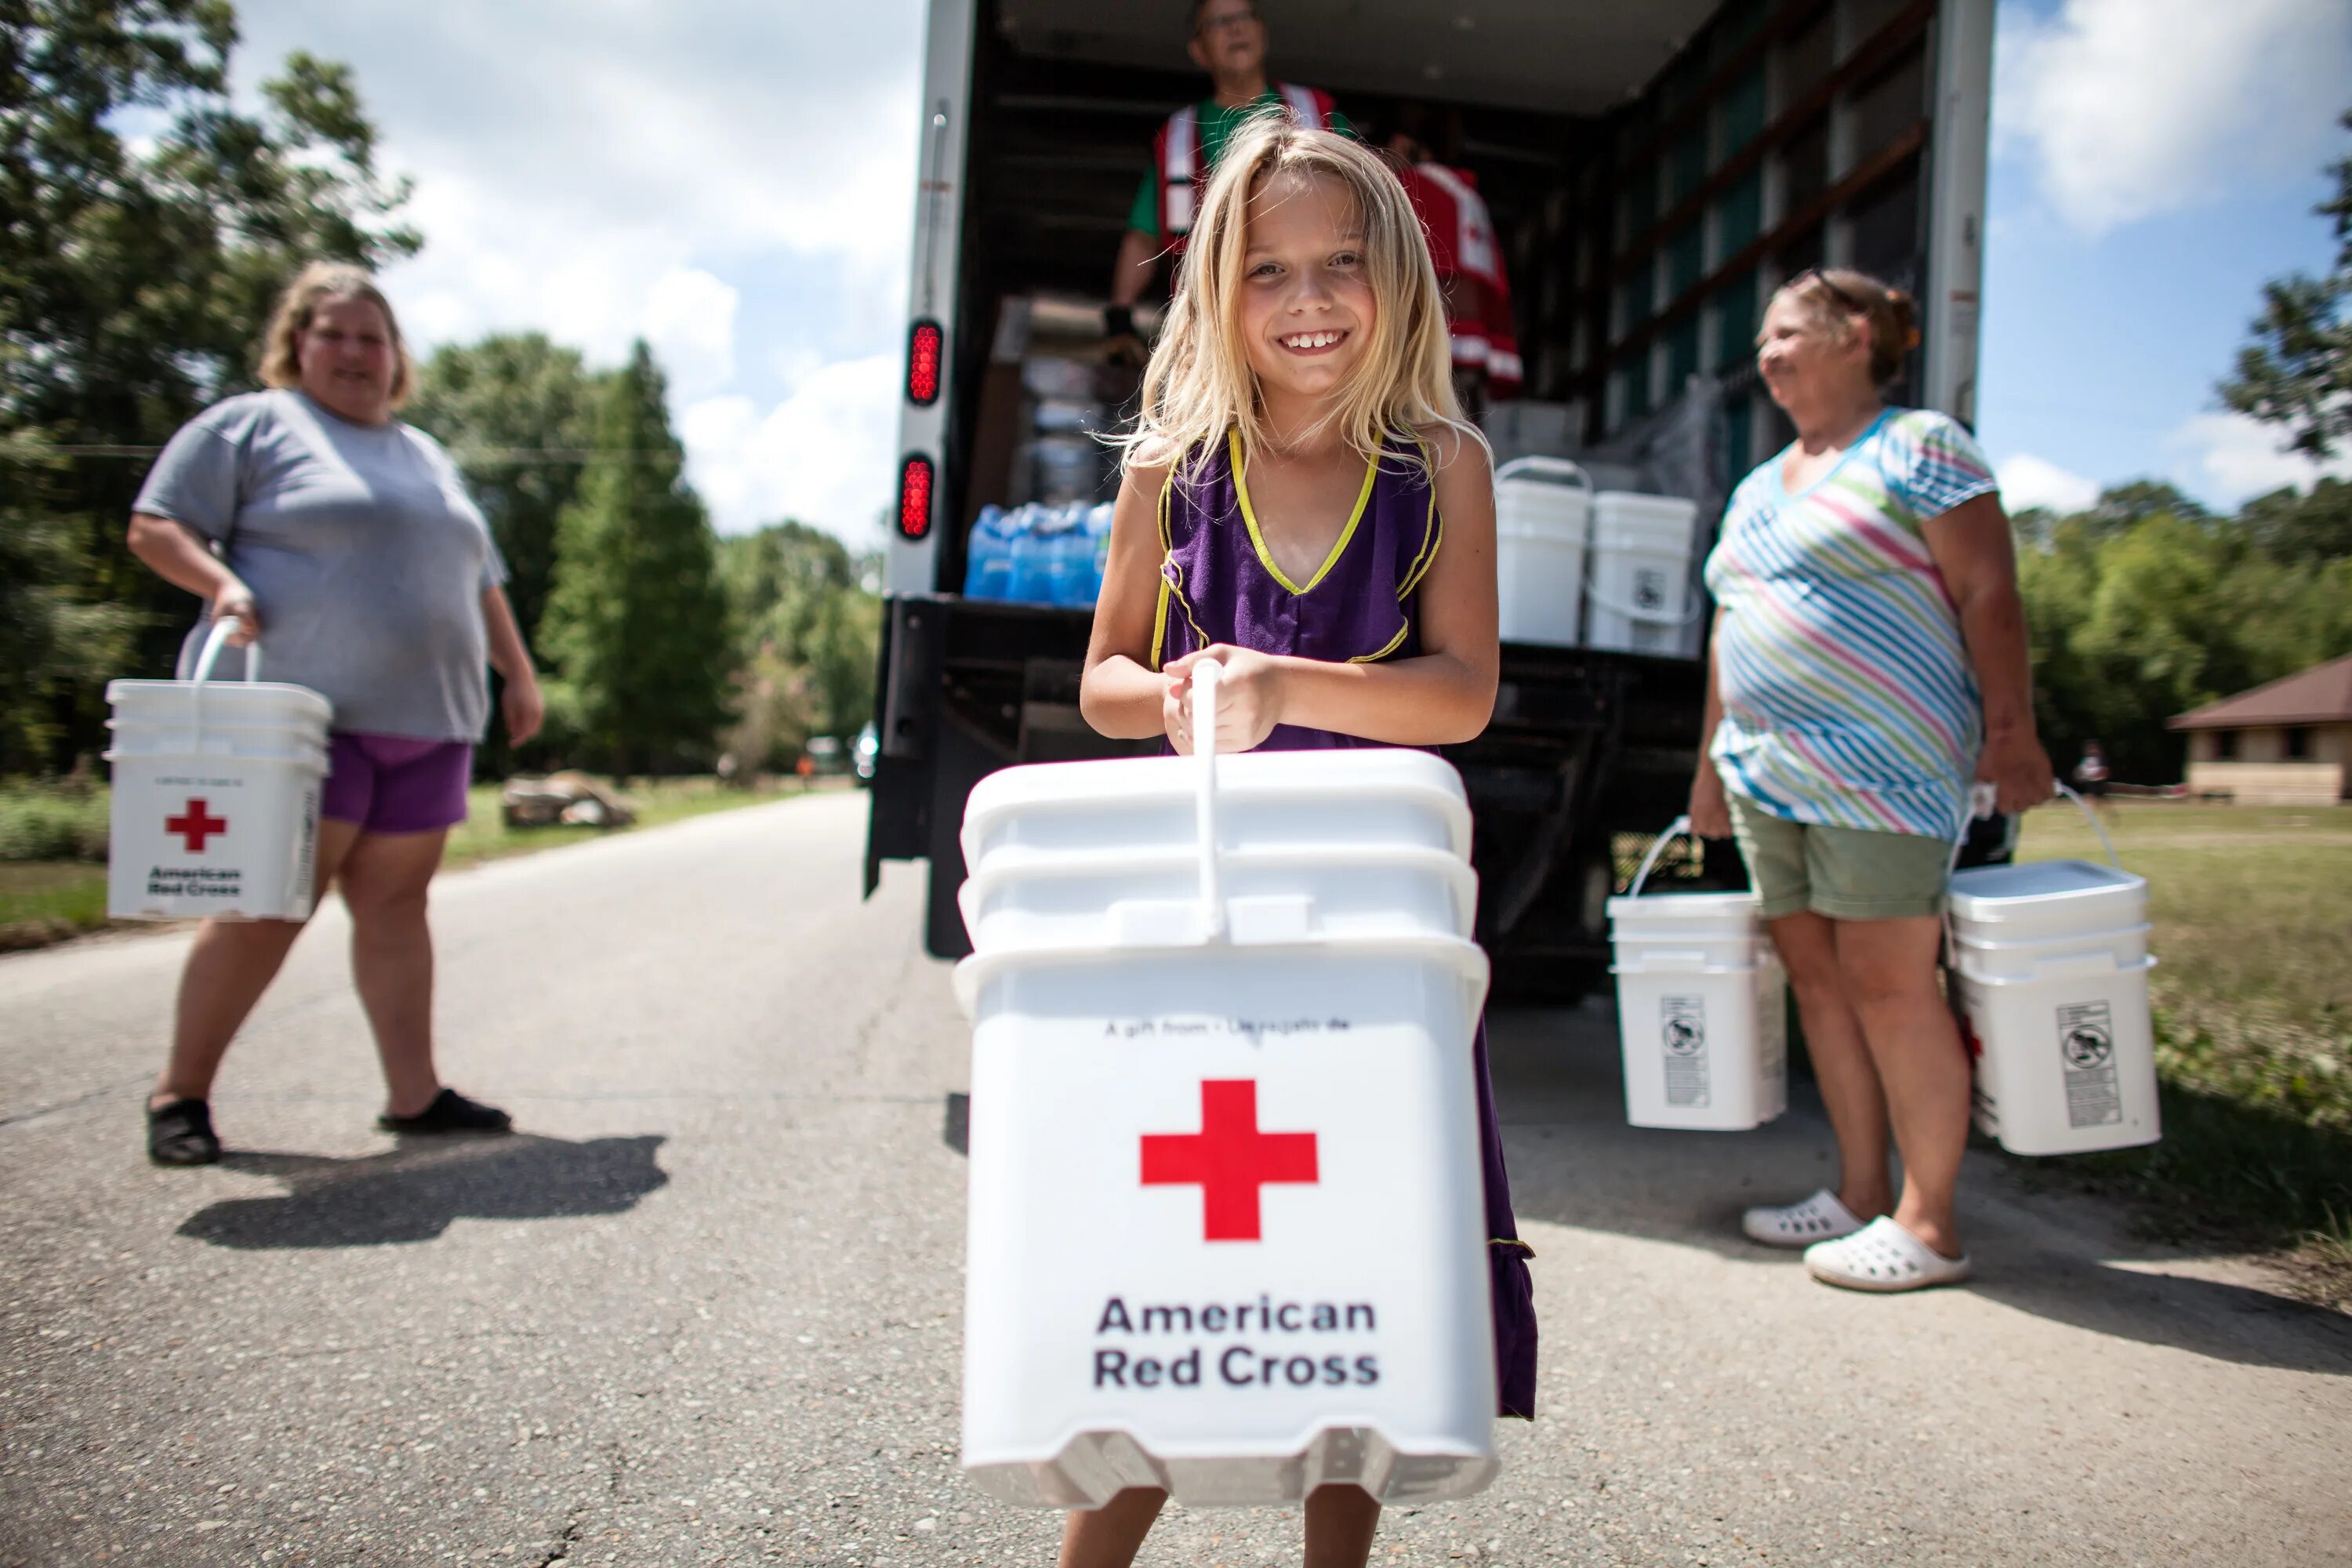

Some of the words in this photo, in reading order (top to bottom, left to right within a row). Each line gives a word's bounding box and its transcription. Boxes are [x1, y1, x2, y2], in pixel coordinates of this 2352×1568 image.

[1105, 1020, 1117, 1036] A
[1124, 1020, 1156, 1039] gift
[1163, 1020, 1209, 1035] from
[1327, 1015, 1350, 1031] de
[1097, 1294, 1376, 1332] American
[1094, 1348, 1200, 1387] Red
[1219, 1345, 1379, 1387] Cross
